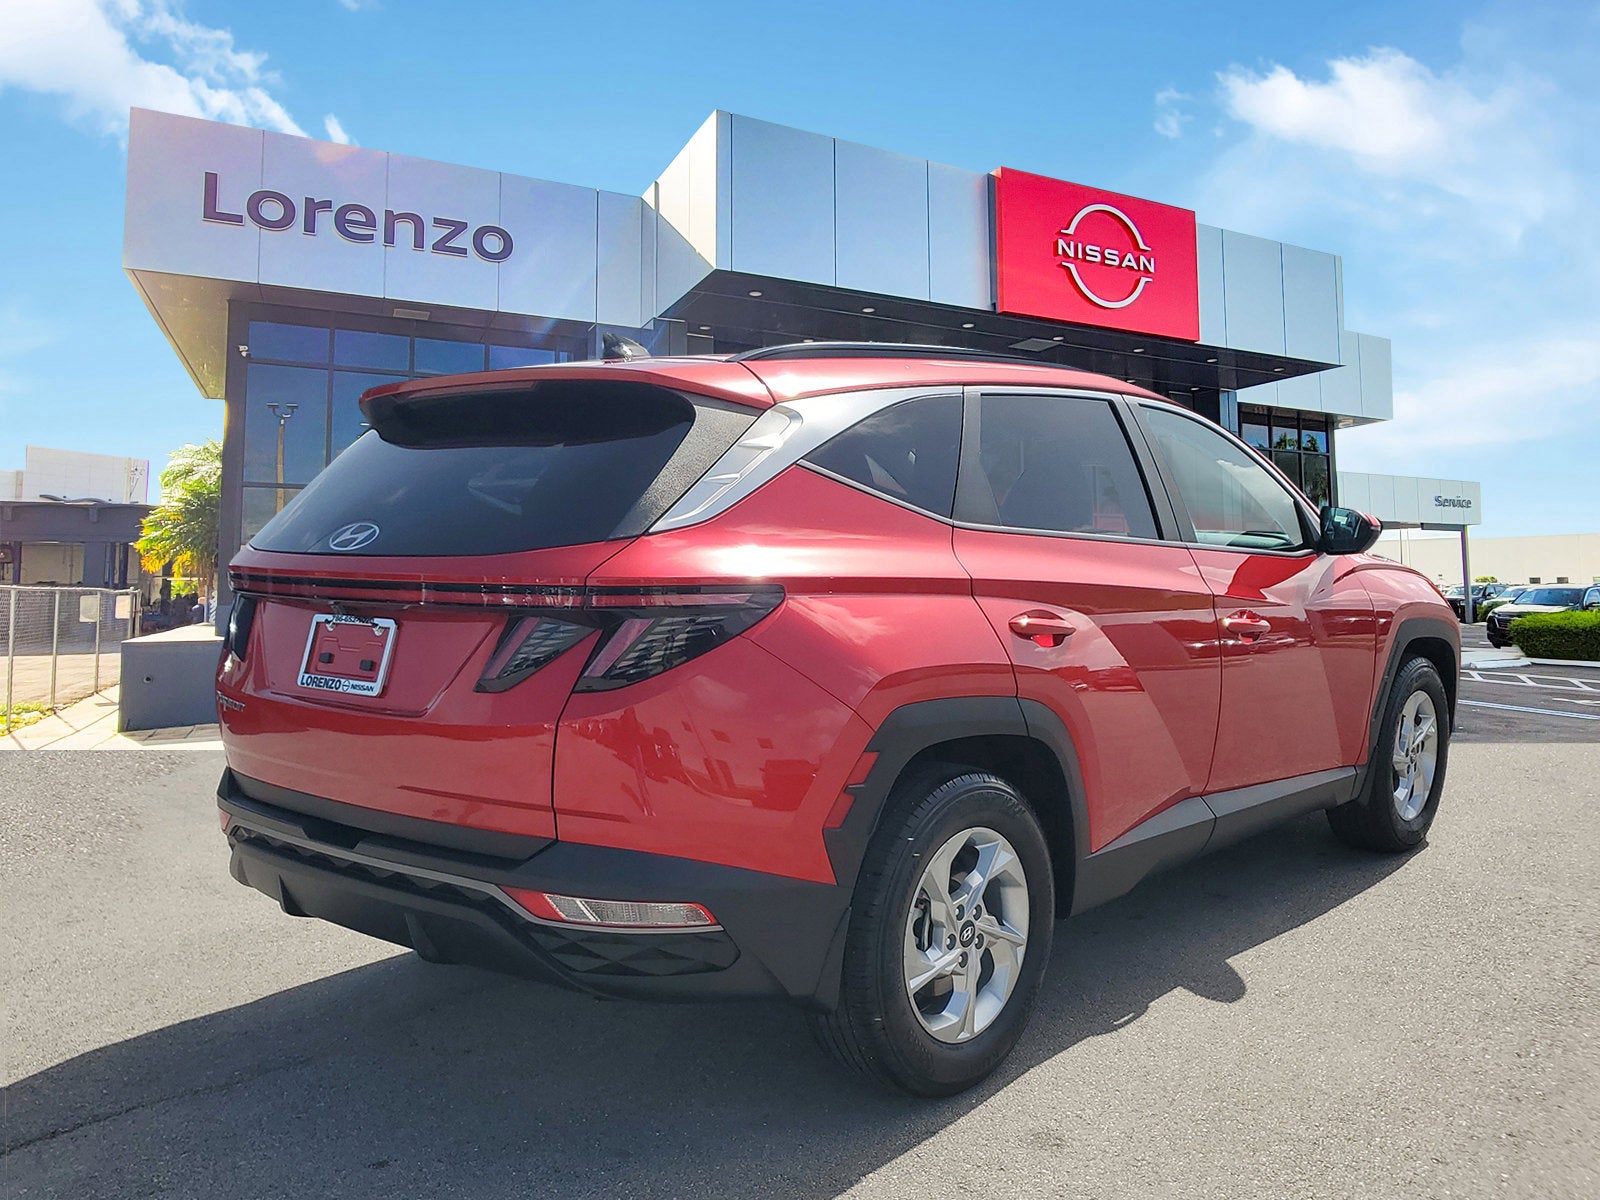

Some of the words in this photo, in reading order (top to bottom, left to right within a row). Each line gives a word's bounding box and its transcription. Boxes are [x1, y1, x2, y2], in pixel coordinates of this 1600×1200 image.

[202, 171, 515, 262] Lorenzo
[1057, 238, 1155, 273] NISSAN
[1434, 495, 1472, 508] Service
[300, 675, 341, 690] LORENZO
[350, 684, 374, 692] NISSAN
